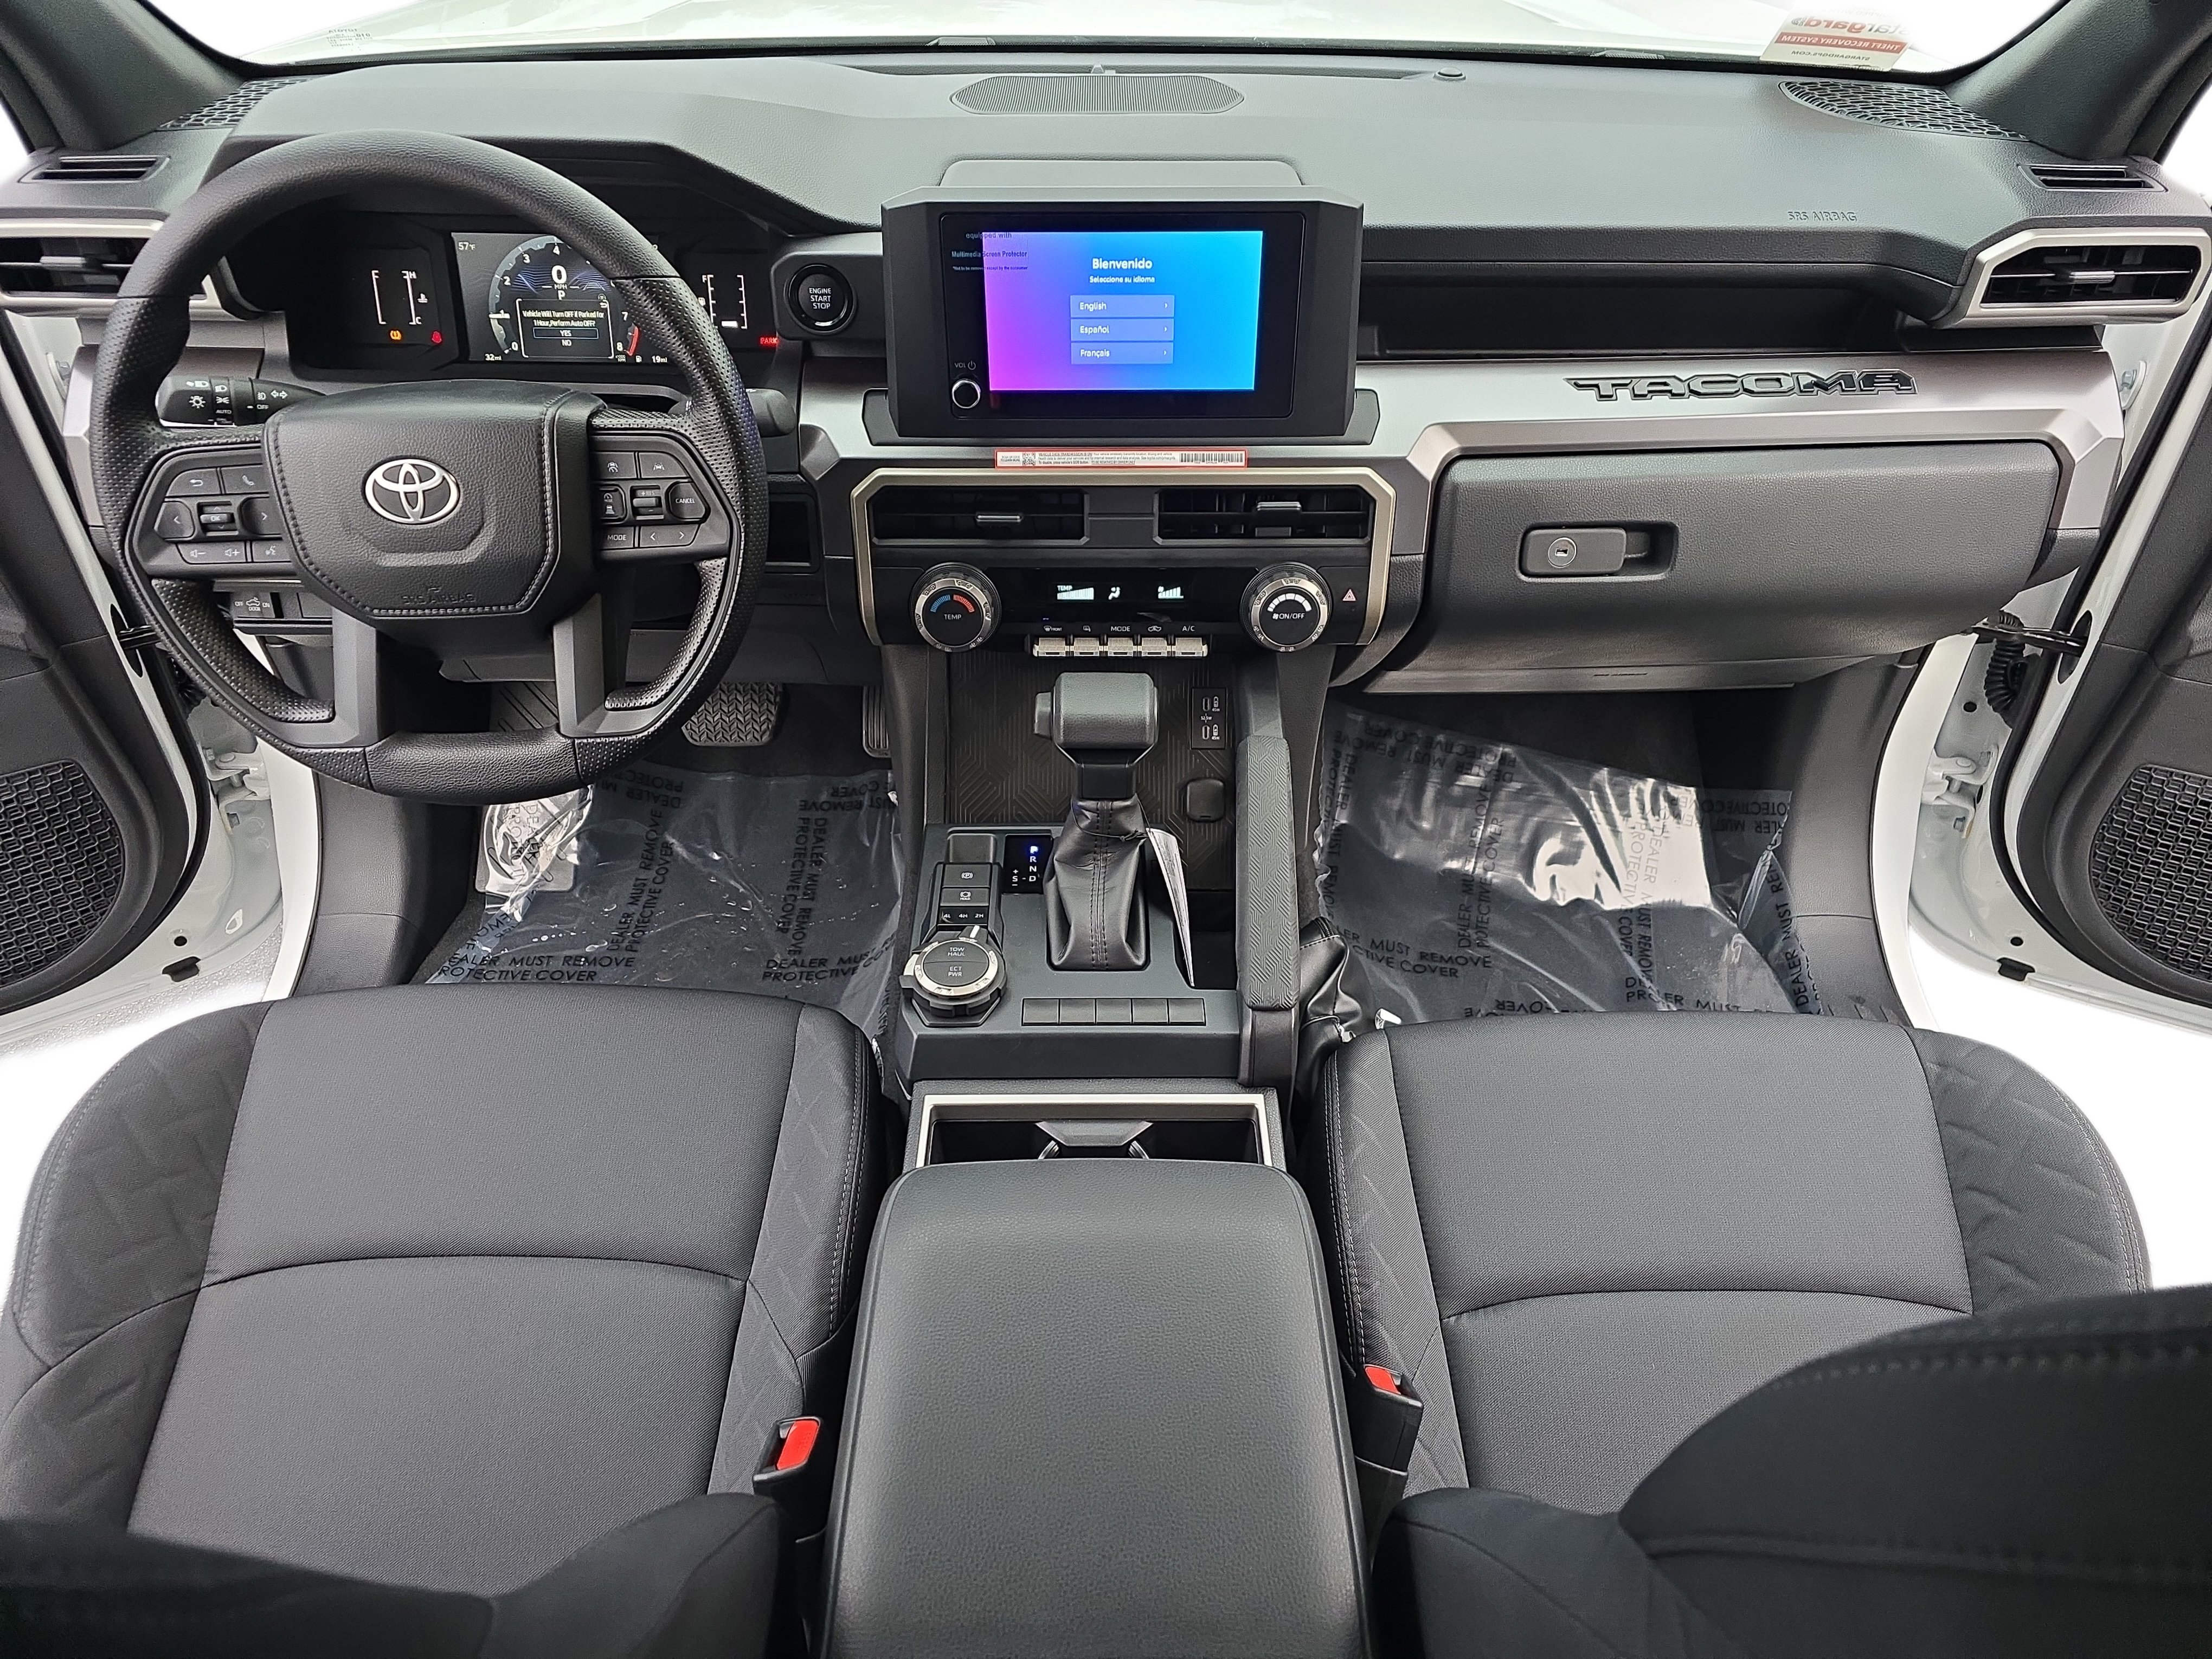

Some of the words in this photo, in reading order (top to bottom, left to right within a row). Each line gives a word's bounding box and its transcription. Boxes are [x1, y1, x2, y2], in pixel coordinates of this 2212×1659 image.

[1787, 211, 1809, 221] SRS
[1812, 211, 1857, 221] AIRBAG
[523, 254, 530, 263] 3
[553, 246, 560, 255] 4
[1092, 258, 1153, 269] Bienvenido
[503, 276, 511, 286] 2
[551, 265, 567, 284] 0
[558, 290, 565, 300] P
[1079, 302, 1107, 312] English
[621, 311, 628, 321] 7
[1080, 325, 1109, 335] Español
[616, 342, 623, 351] 8
[1080, 349, 1110, 358] Français
[1565, 369, 1918, 401] TACOMA
[1726, 801, 1788, 815] OTECTIVE
[810, 818, 827, 867] DEALER
[1483, 817, 1504, 872] COVER
[787, 817, 811, 891] PROTECTIVE
[1643, 825, 1663, 884] DEALER
[607, 912, 635, 950] DEALER
[628, 877, 648, 905] MUST
[639, 809, 662, 870] REMOVE
[802, 873, 819, 902] MUST
[625, 888, 662, 953] PROTECTIVE
[652, 841, 674, 884] COVER
[775, 895, 797, 934] COVER
[1776, 902, 1792, 941] MUST
[787, 907, 812, 955] REMOVE
[1371, 938, 1410, 956] MUST
[1420, 951, 1491, 968] REMOVE
[510, 955, 554, 967] MUST
[562, 955, 635, 968] REMOVE
[766, 958, 828, 969] DEALER
[1400, 959, 1458, 978] COVER
[439, 966, 531, 981] ROTECTIVE
[536, 970, 597, 982] COVER
[762, 965, 859, 981] PROTECTIVE
[1785, 949, 1810, 1008] DEALER
[1495, 999, 1545, 1014] OVER
